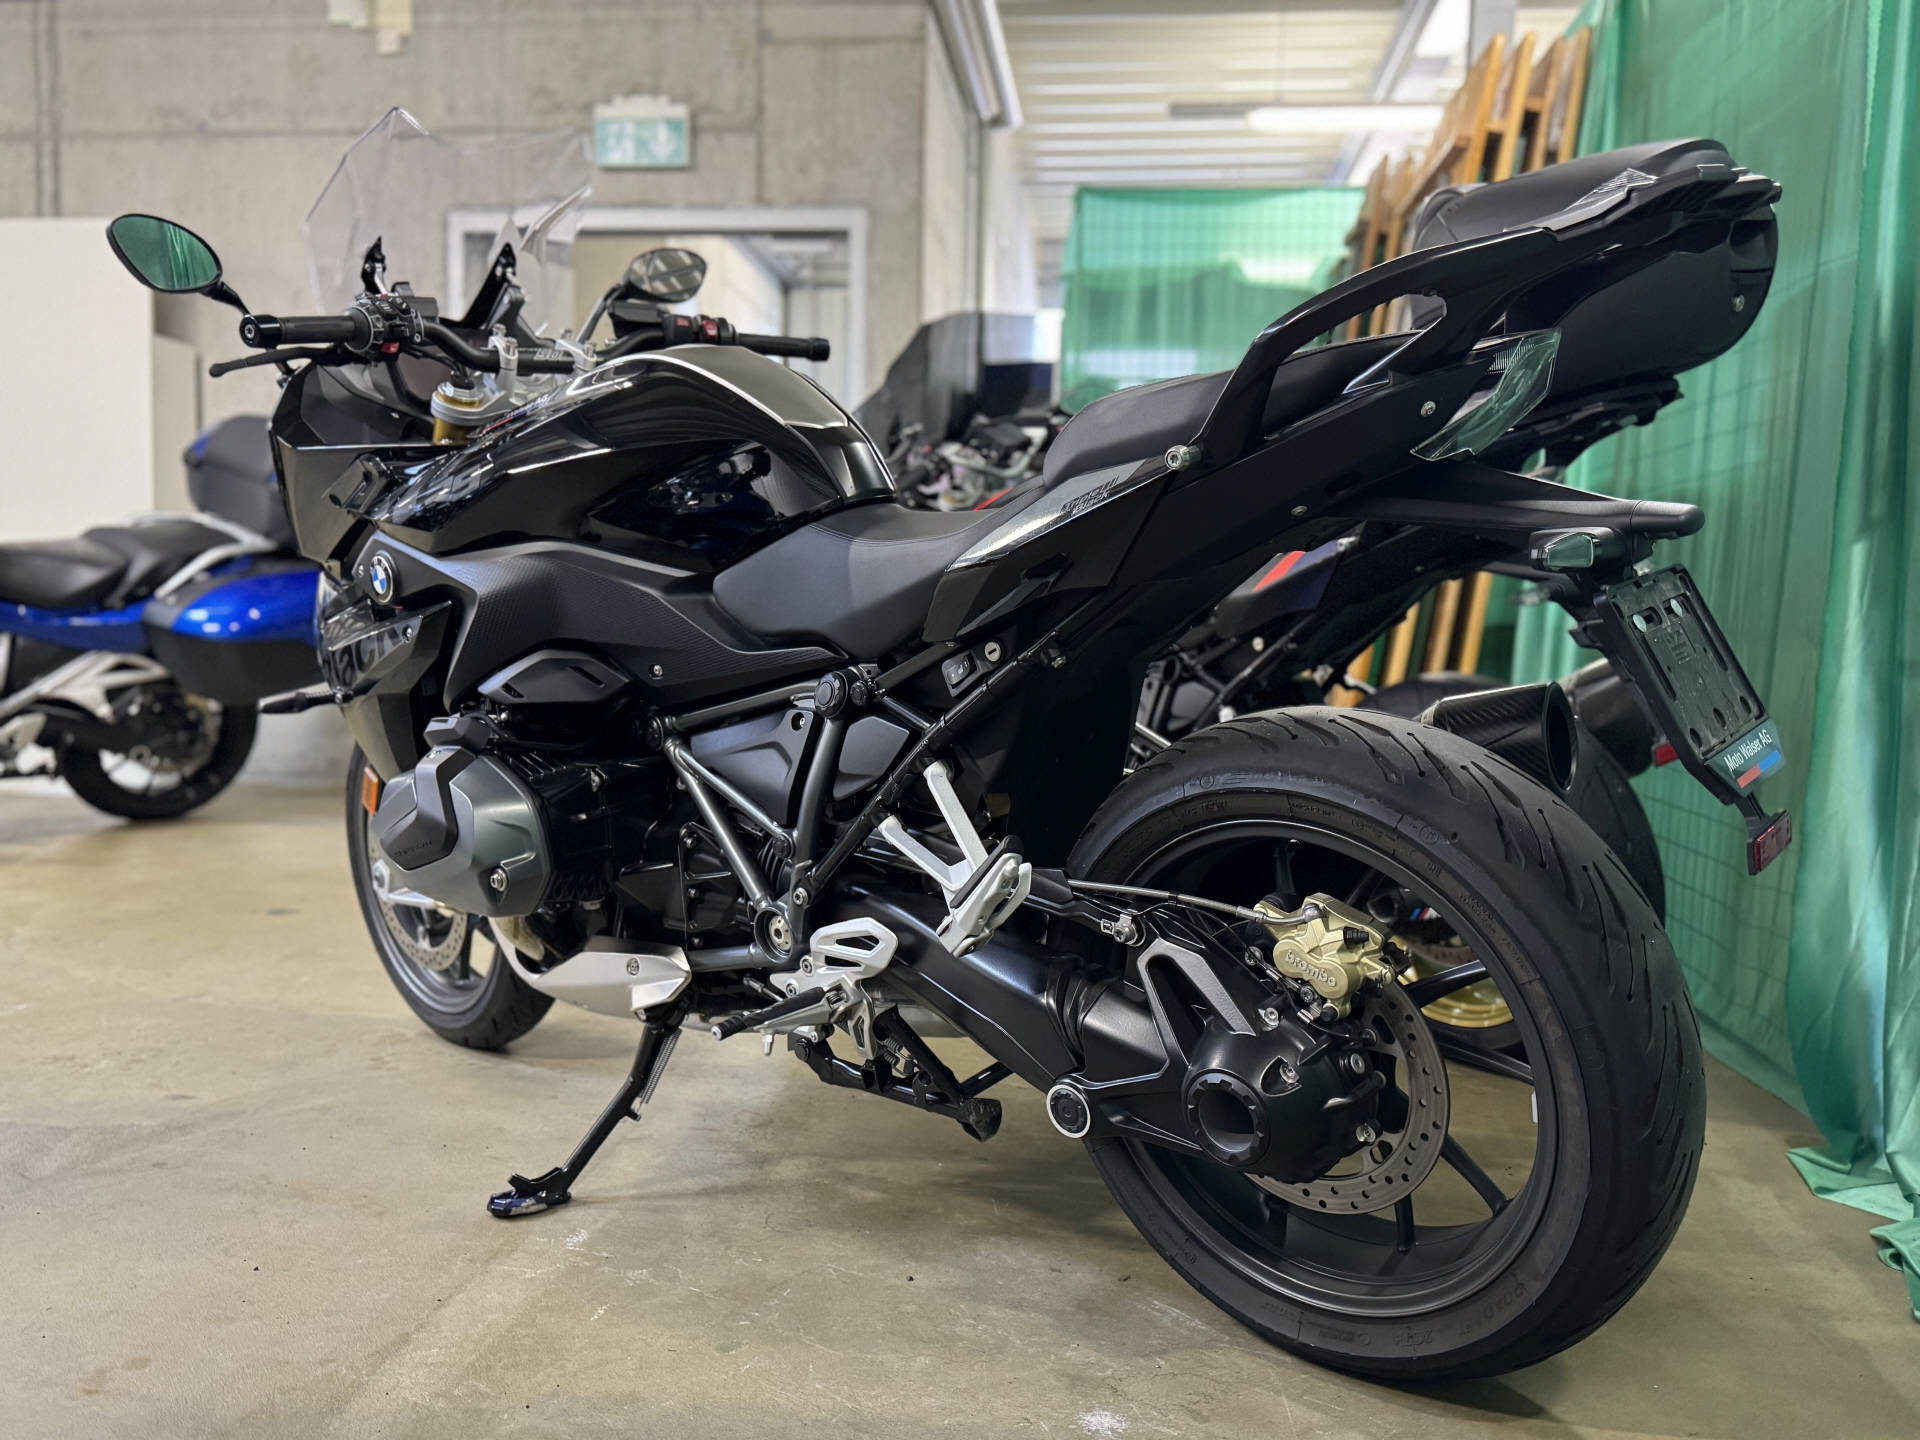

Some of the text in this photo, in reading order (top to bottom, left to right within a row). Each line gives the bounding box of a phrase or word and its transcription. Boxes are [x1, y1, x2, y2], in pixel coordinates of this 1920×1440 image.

[1723, 729, 1772, 775] Moto Walser AG
[1286, 950, 1337, 987] brembo
